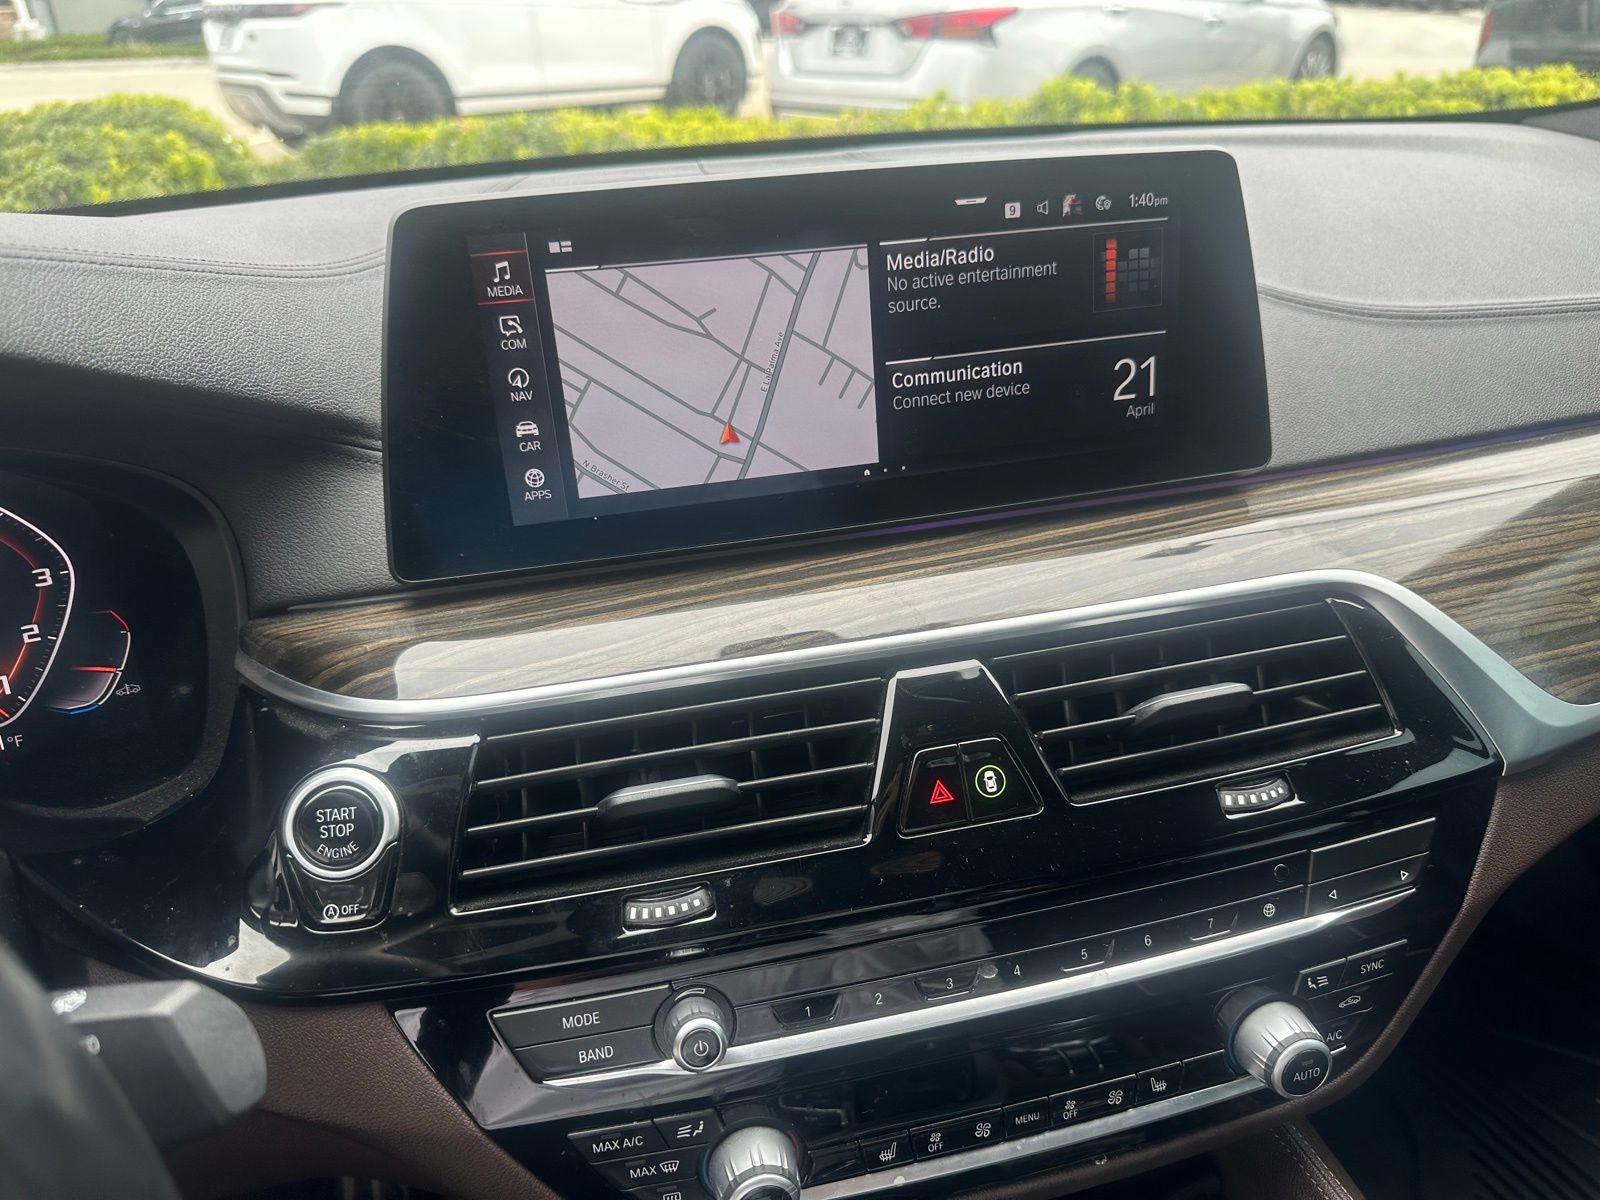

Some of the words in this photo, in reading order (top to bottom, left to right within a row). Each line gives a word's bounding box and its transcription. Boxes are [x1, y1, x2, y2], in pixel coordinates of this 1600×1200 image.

[1128, 192, 1168, 208] 1:40pm
[886, 245, 995, 271] Media/Radio
[887, 277, 908, 291] No
[912, 272, 954, 290] active
[958, 261, 1057, 285] entertainment
[487, 285, 524, 298] MEDIA
[888, 297, 941, 314] source.
[501, 339, 527, 350] COM
[766, 348, 778, 374] Palma
[774, 332, 785, 347] Ave
[891, 360, 1023, 389] Communication
[1112, 355, 1157, 401] 21
[510, 390, 533, 402] NAV
[893, 389, 951, 410] Connect
[955, 387, 982, 403] new
[986, 381, 1031, 400] device
[1126, 403, 1154, 419] April
[519, 440, 541, 452] CAR
[582, 459, 591, 468] N
[590, 464, 620, 486] Brasher
[620, 482, 630, 491] St
[524, 489, 552, 501] APPS
[31, 567, 53, 588] 3
[20, 623, 42, 644] 2
[316, 806, 358, 823] START
[320, 823, 355, 839] STOP
[316, 840, 360, 859] ENGINE
[341, 903, 360, 916] OFF
[1207, 917, 1214, 928] 7
[1144, 934, 1152, 946] 6
[1080, 948, 1088, 960] 5
[1013, 964, 1021, 977] 4
[1360, 959, 1385, 974] SYNC
[945, 977, 954, 990] 3
[874, 992, 883, 1005] 2
[804, 1006, 811, 1017] 1
[562, 1011, 600, 1029] MODE
[1326, 1029, 1343, 1042] A/C
[578, 1045, 614, 1064] BAND
[1292, 1067, 1321, 1083] AUTO
[1015, 1111, 1040, 1126] MENU
[1062, 1108, 1078, 1120] OFF
[592, 1139, 620, 1154] MAX
[622, 1135, 644, 1149] A/C
[927, 1141, 944, 1153] OFF
[629, 1165, 657, 1179] MAX
